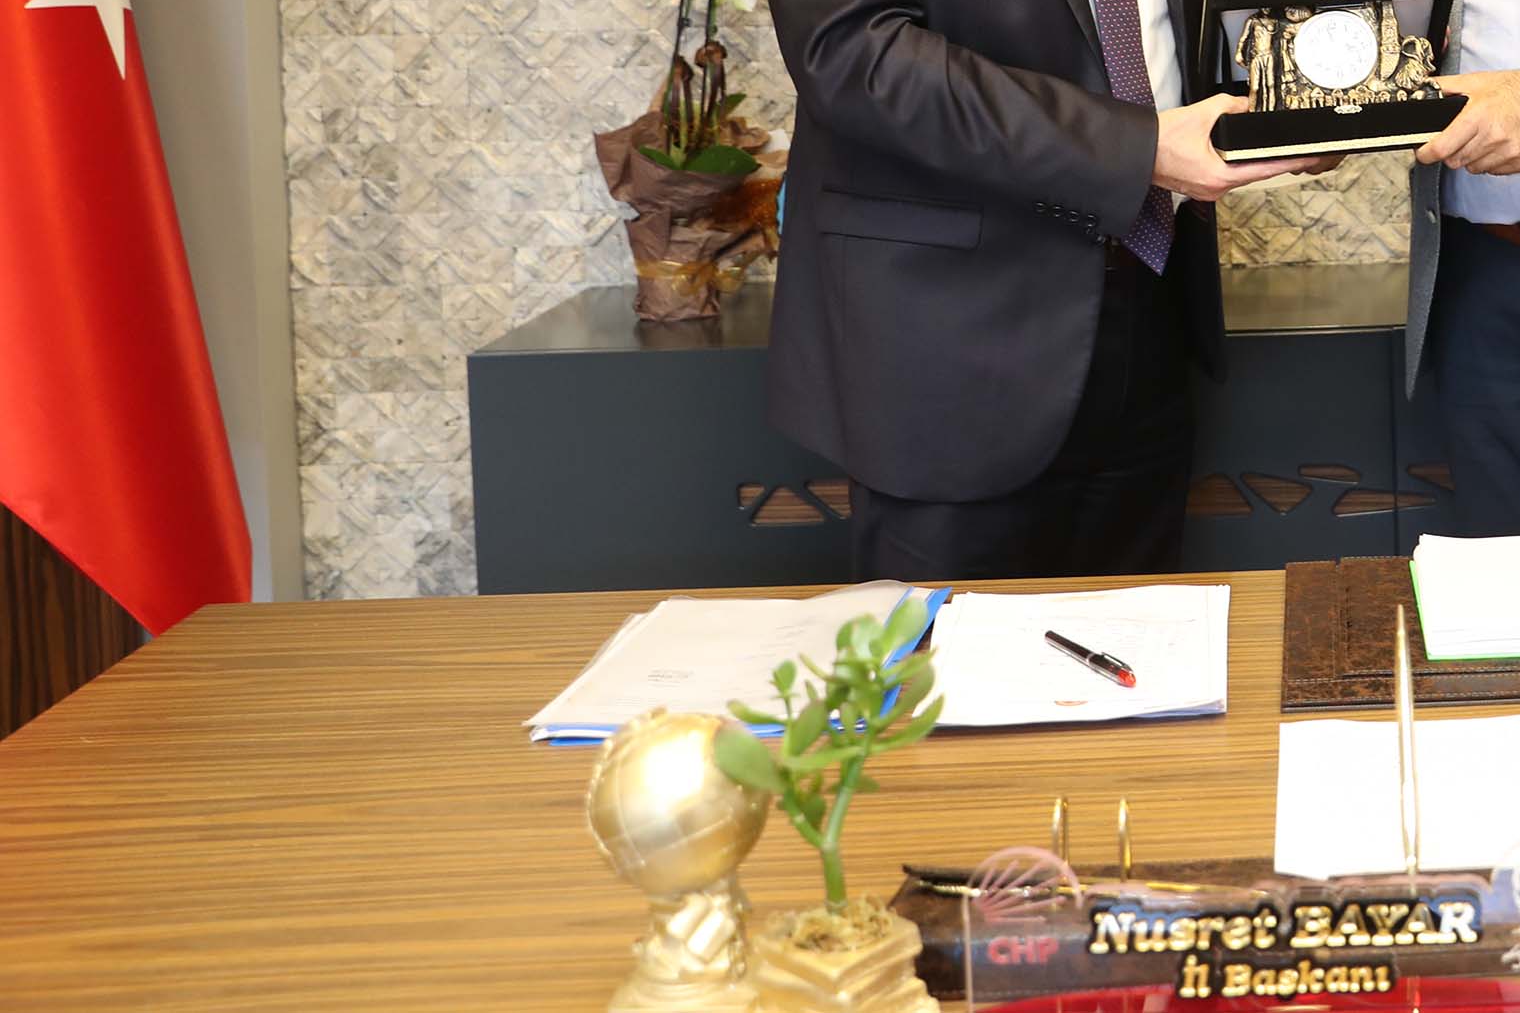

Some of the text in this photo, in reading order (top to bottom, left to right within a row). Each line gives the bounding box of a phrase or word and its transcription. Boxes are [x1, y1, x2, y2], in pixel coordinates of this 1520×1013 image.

[1090, 904, 1478, 954] Nusret BAYAR
[987, 935, 1060, 965] CHP
